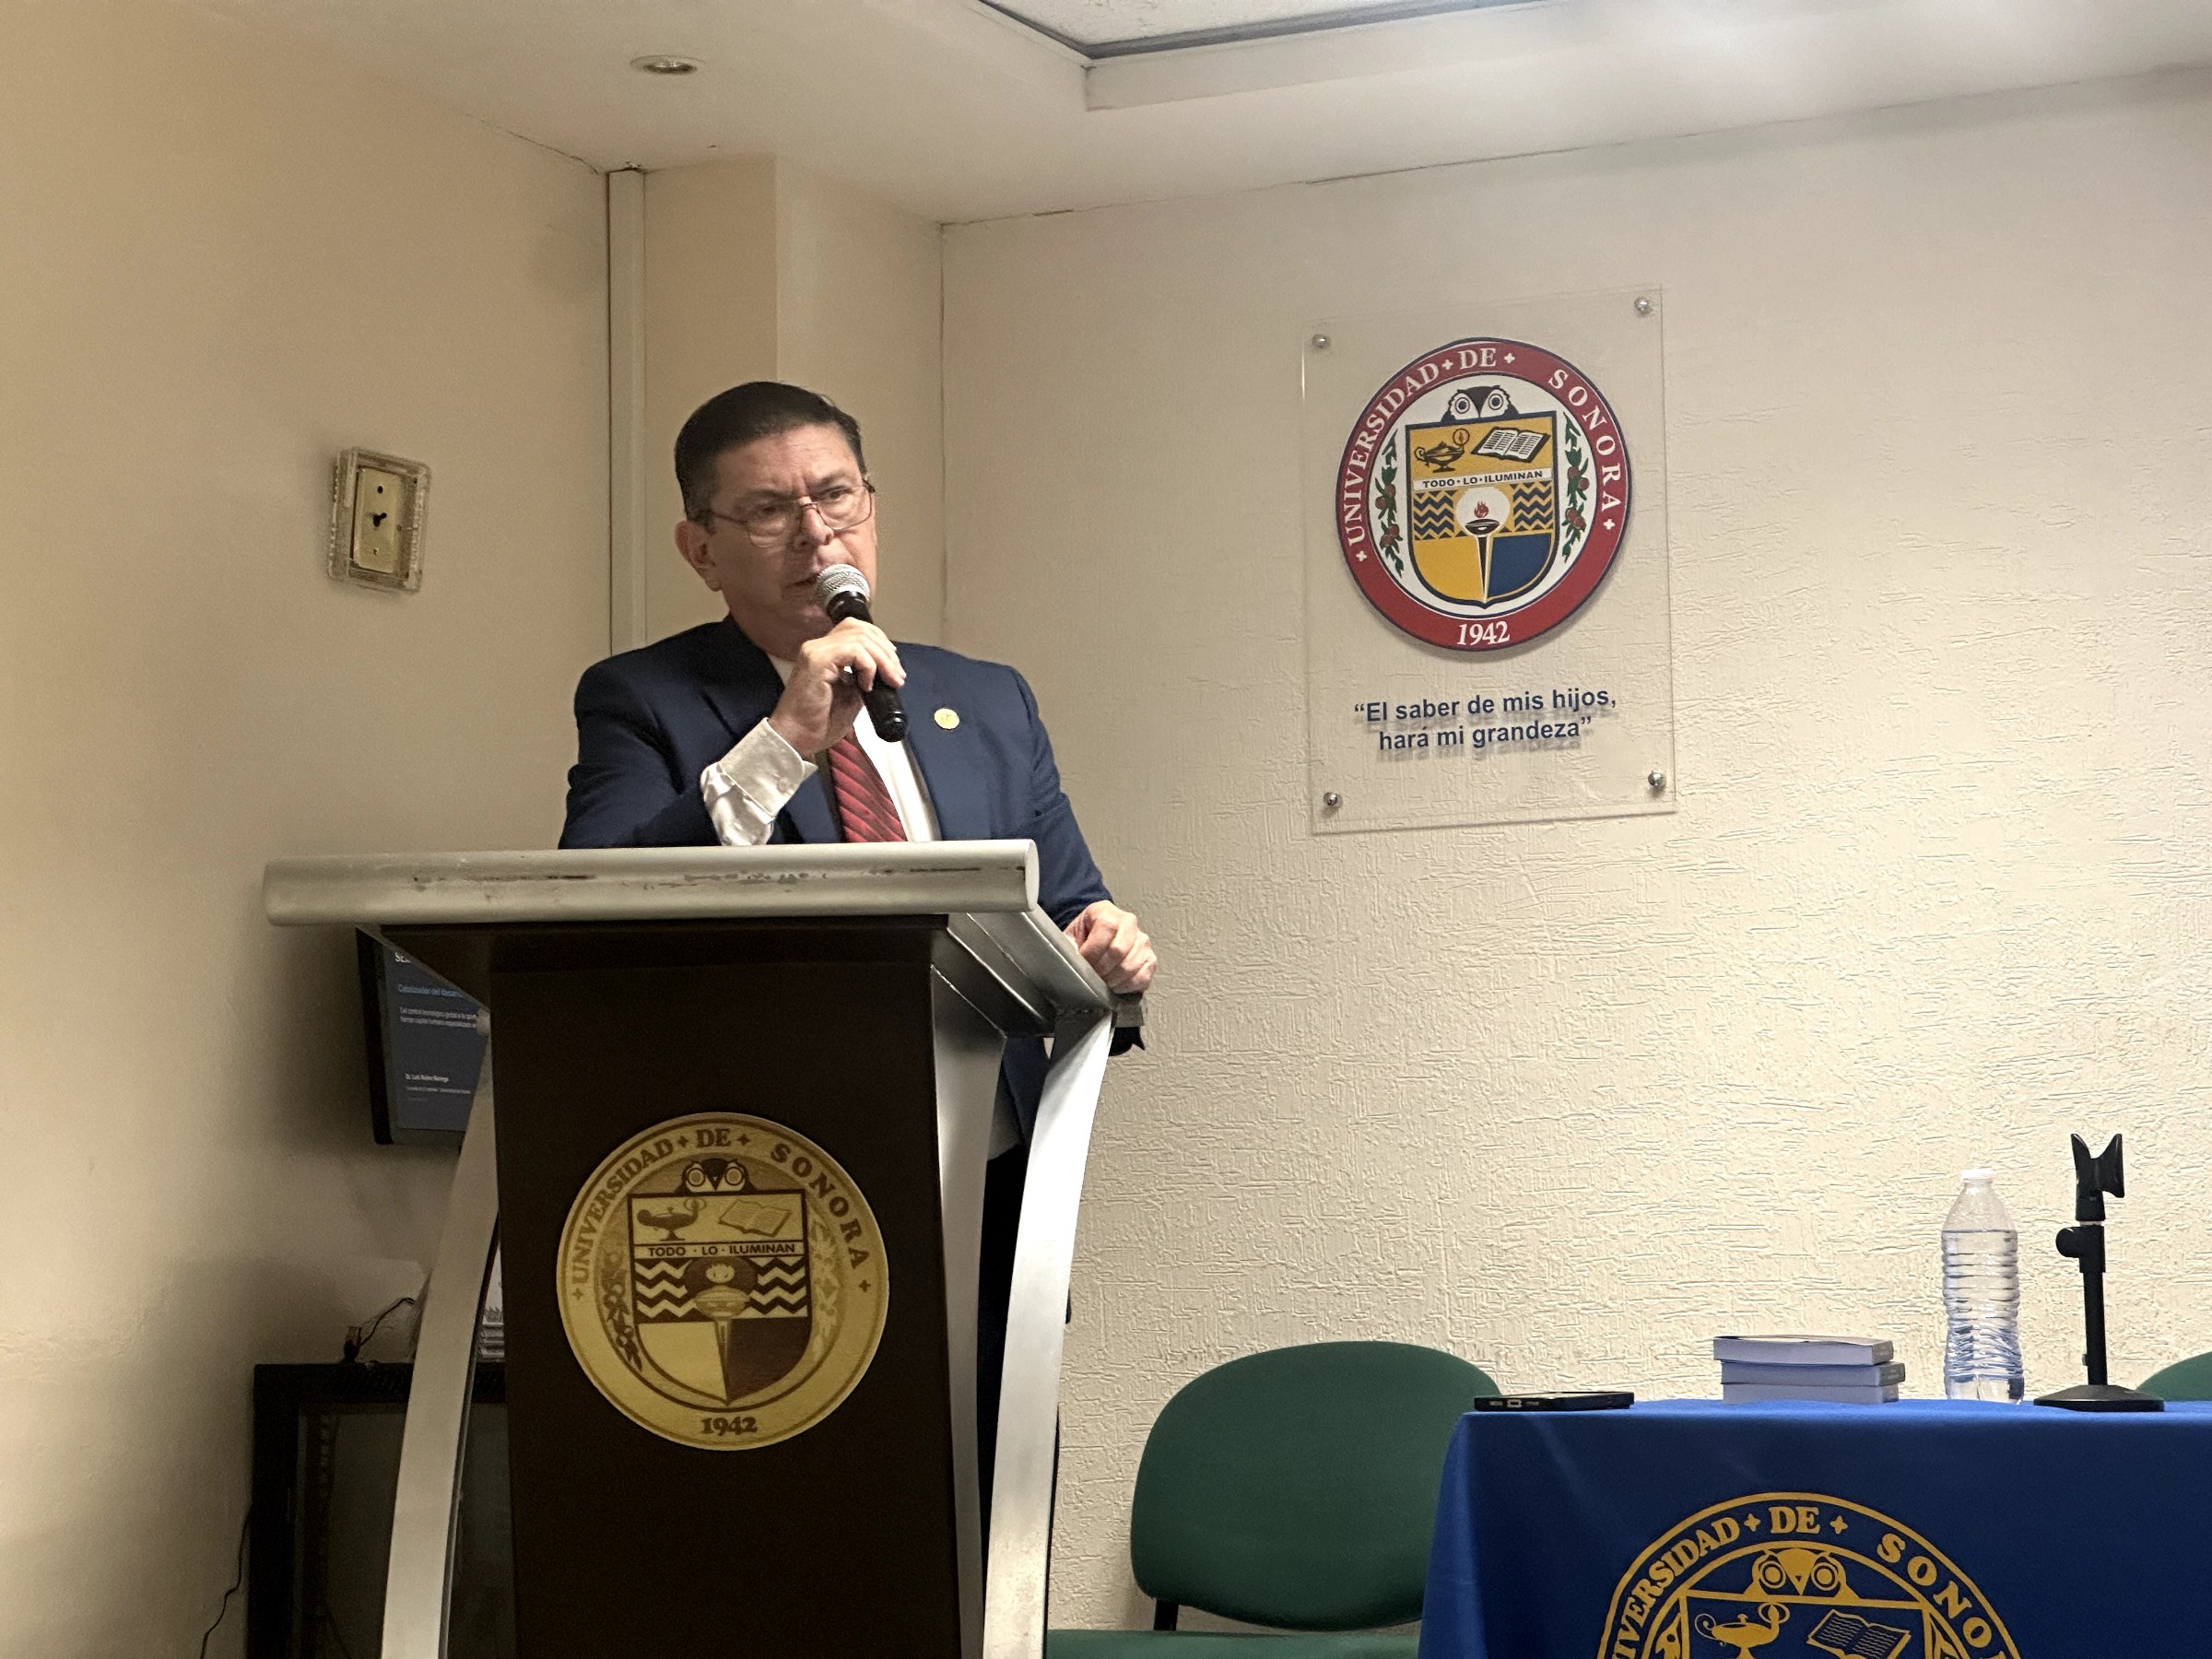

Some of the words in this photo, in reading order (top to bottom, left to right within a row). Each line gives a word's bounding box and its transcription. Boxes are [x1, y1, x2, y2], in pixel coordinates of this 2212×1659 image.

[1344, 362, 1440, 547] UNIVERSIDAD
[1458, 347, 1497, 370] DE
[1548, 369, 1622, 512] SONORA
[1422, 477, 1455, 488] TODO
[1463, 477, 1477, 486] LO
[1484, 470, 1543, 483] ILUMINAN
[1456, 620, 1511, 646] 1942
[1354, 701, 1388, 722] “El
[1395, 699, 1460, 720] saber
[1467, 695, 1495, 714] de
[1503, 691, 1544, 712] mis
[1552, 688, 1617, 712] hijos,
[1379, 726, 1430, 750] hará
[1437, 725, 1465, 747] mi
[1472, 716, 1592, 748] grandeza”
[571, 1137, 674, 1284] UNIVERSIDAD
[696, 1128, 733, 1148] DE
[771, 1143, 870, 1269] SONORA
[648, 1246, 687, 1257] TODO
[701, 1246, 719, 1256] LO
[729, 1243, 795, 1254] ILUMINAN
[700, 1417, 759, 1436] 1942
[1769, 1506, 1820, 1535] DE
[1877, 1533, 2007, 1659] SONO
